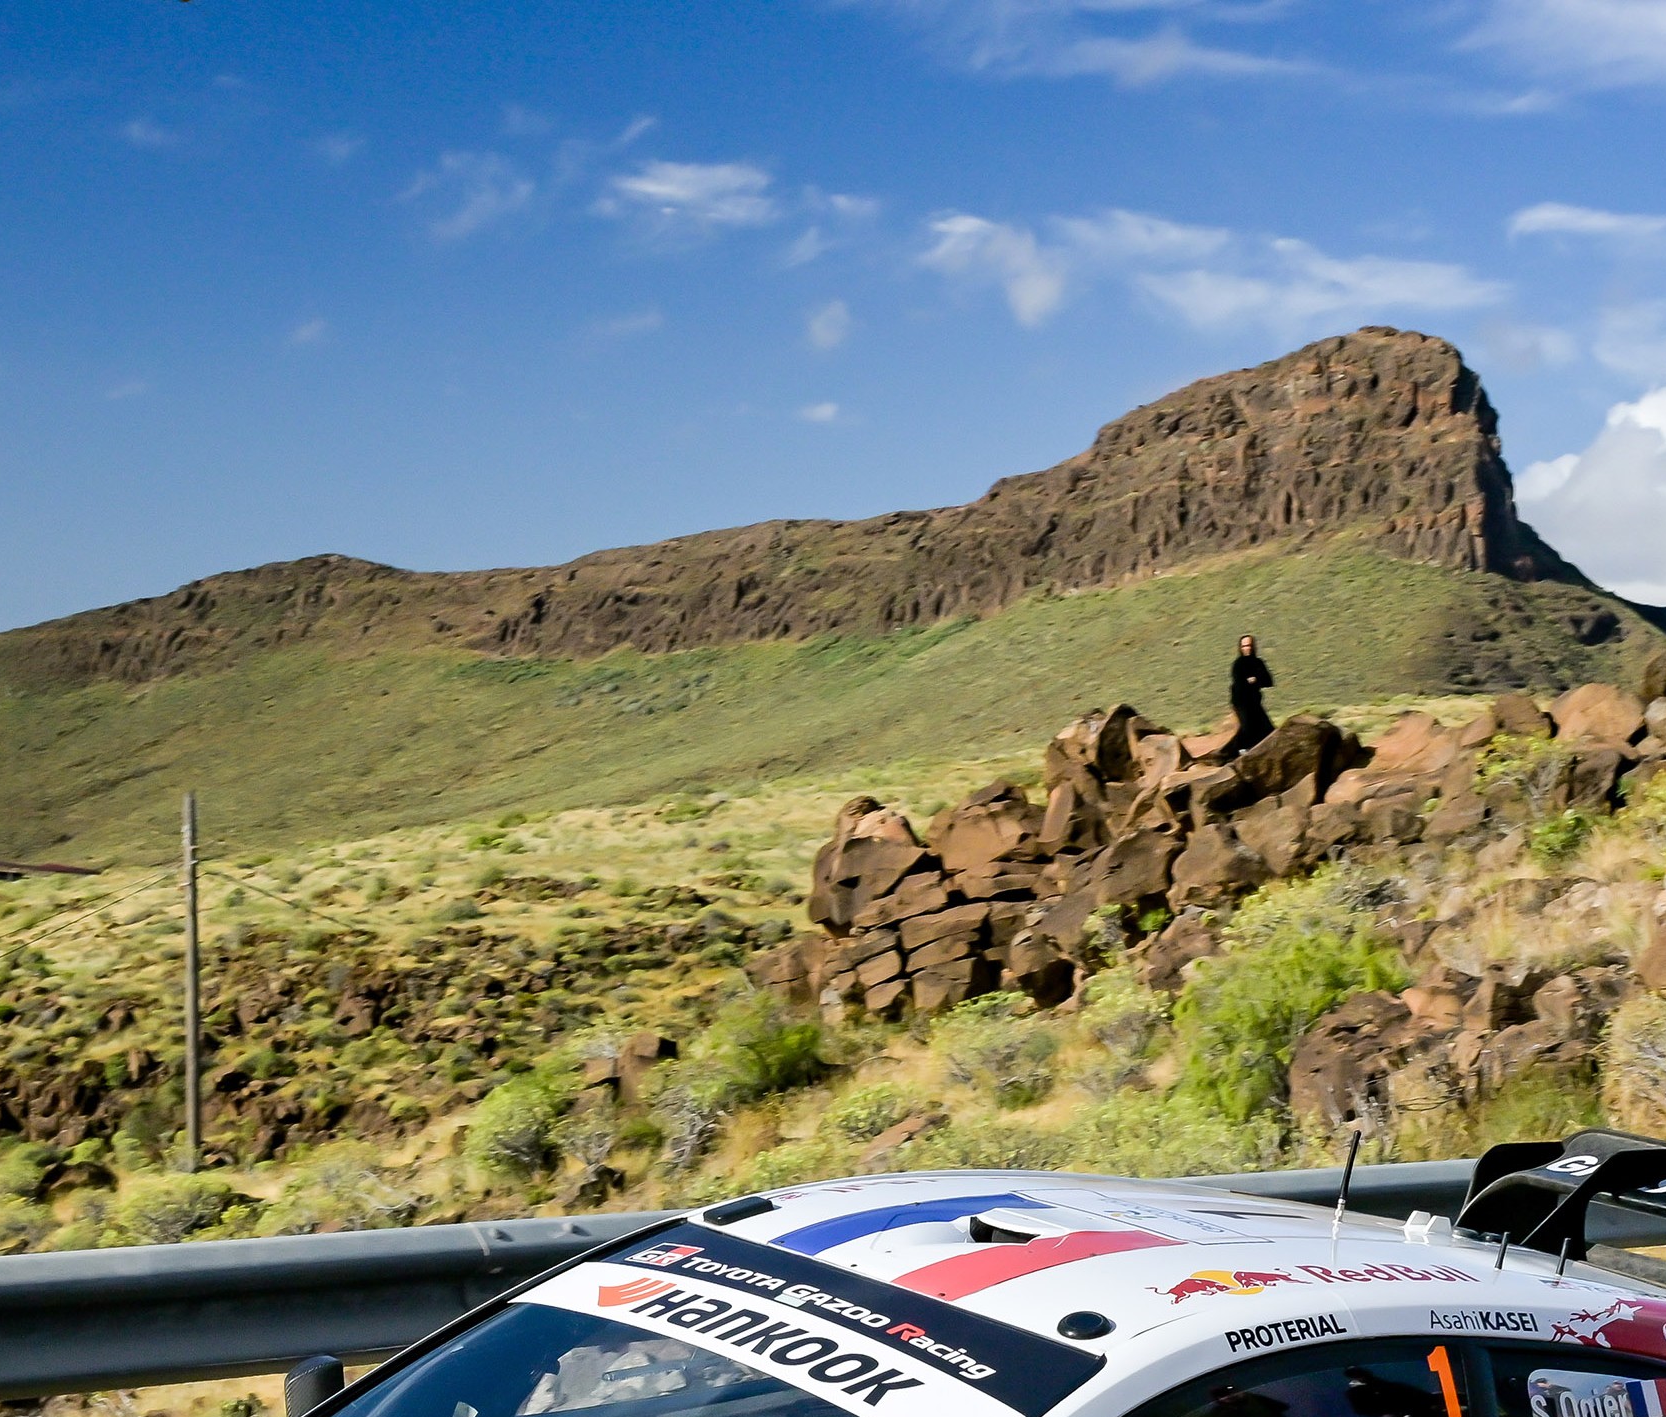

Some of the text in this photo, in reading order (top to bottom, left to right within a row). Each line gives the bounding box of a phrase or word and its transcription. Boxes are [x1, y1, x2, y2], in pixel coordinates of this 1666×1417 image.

[681, 1256, 787, 1291] TOYOTA
[781, 1283, 892, 1329] GAZOO
[885, 1322, 997, 1380] Racing
[1225, 1313, 1347, 1353] PROTERIAL
